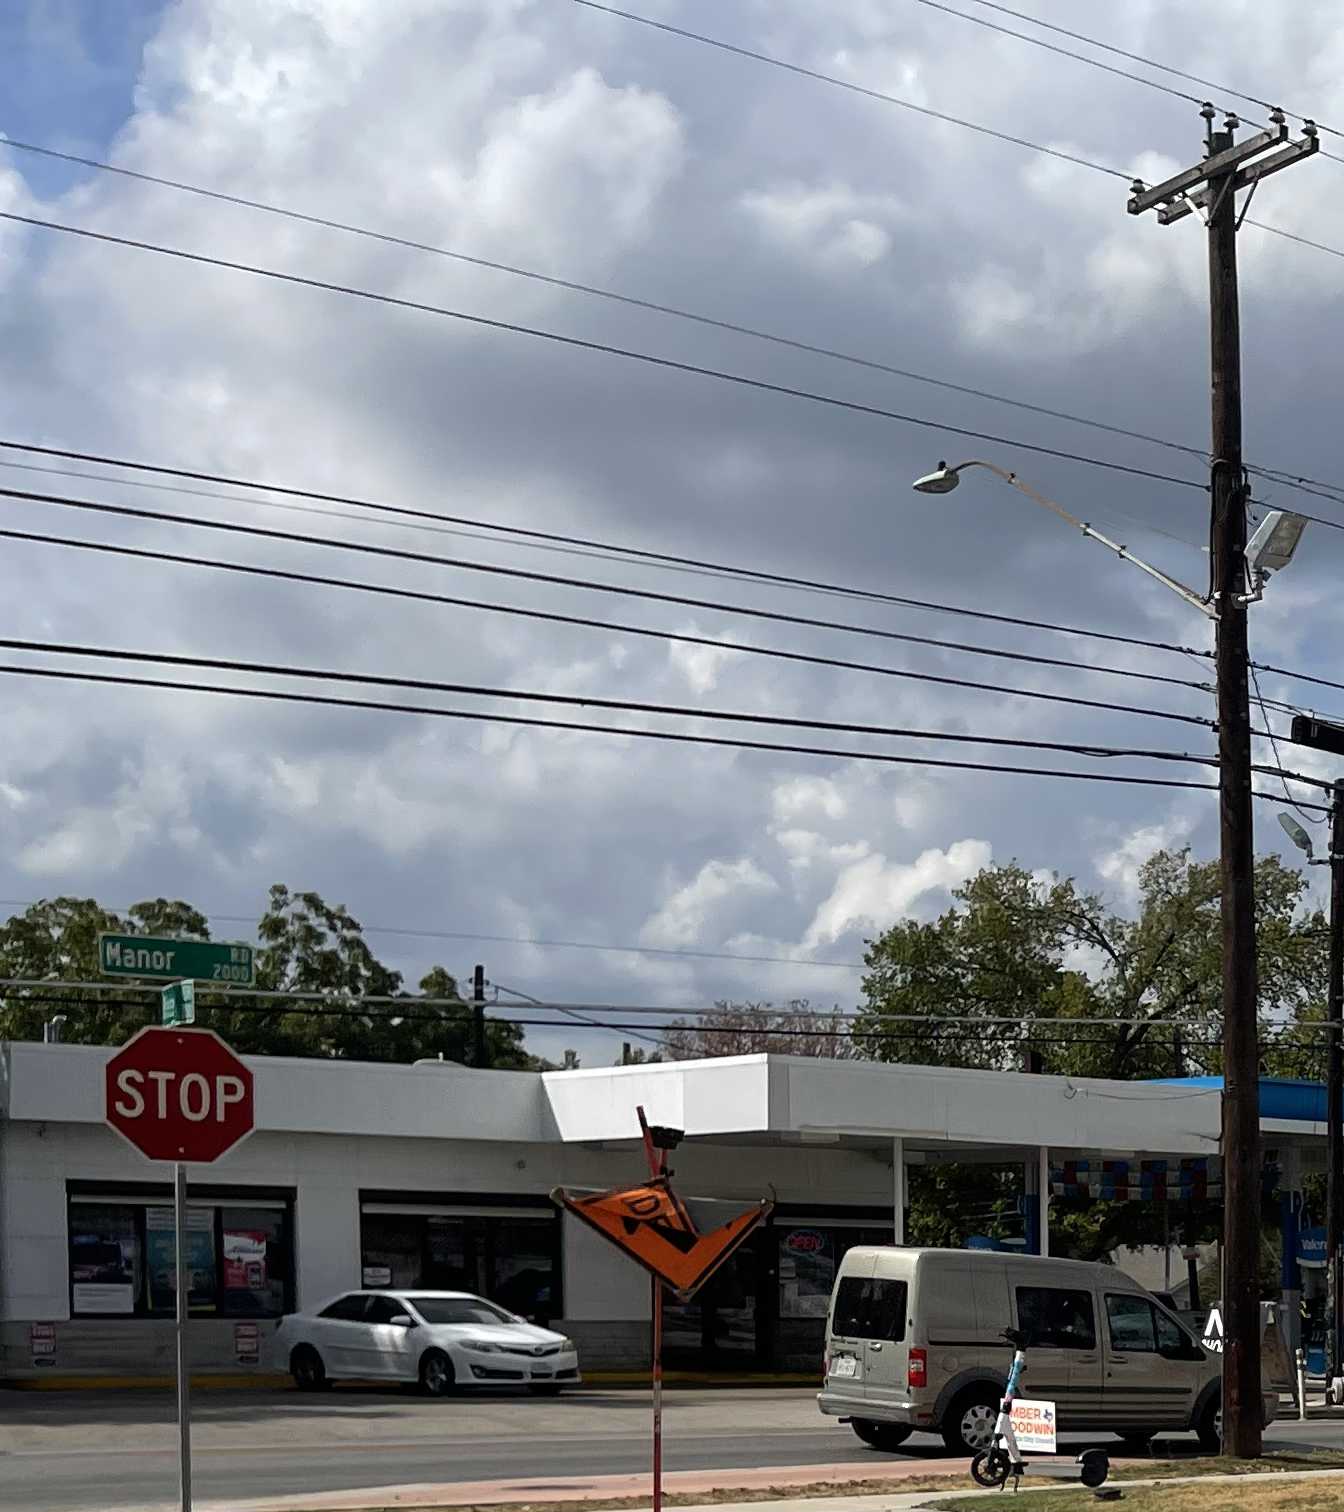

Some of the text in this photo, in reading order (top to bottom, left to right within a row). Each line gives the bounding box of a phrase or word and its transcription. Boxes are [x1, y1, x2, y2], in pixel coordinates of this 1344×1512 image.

[106, 942, 176, 970] Manor
[115, 1069, 245, 1122] STOP
[1009, 1407, 1041, 1420] MBER
[1011, 1421, 1054, 1436] OODWIN
